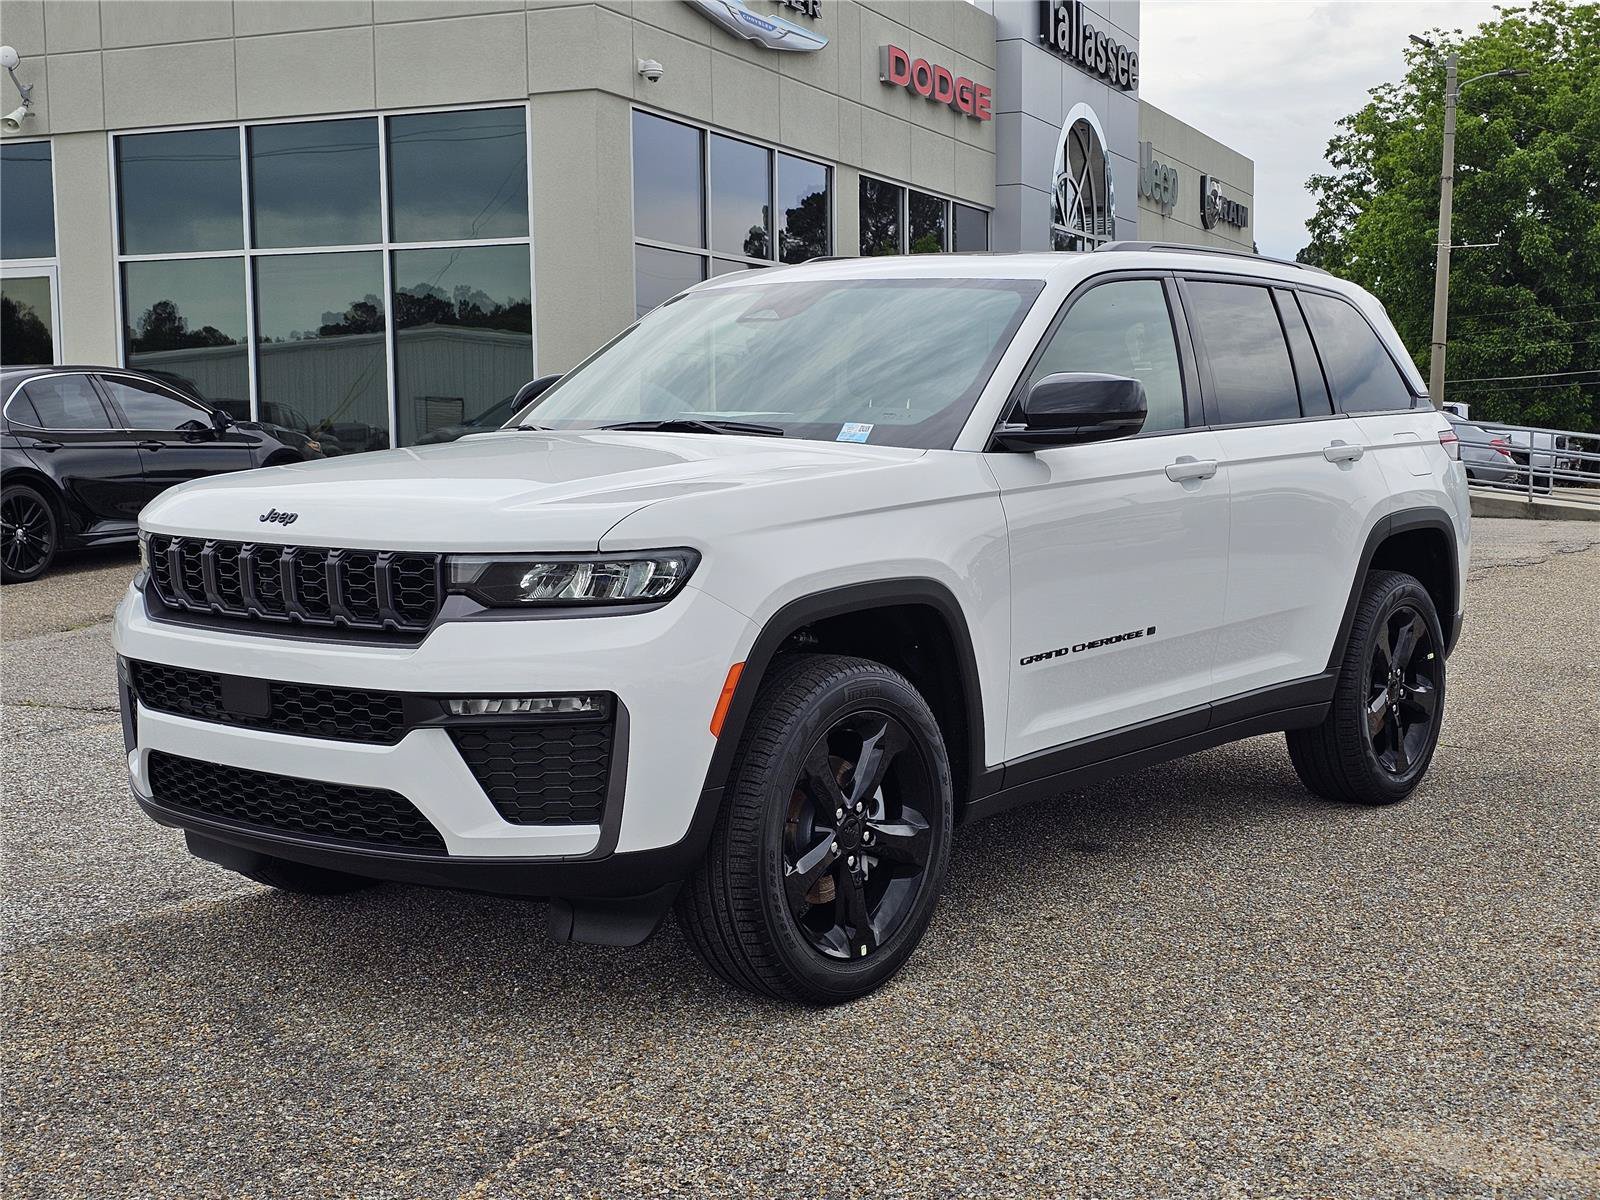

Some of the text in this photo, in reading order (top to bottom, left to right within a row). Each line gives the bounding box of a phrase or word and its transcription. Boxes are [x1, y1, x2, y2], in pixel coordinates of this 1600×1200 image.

[1047, 0, 1139, 91] Tallassee
[886, 44, 992, 121] DODGE
[1138, 141, 1178, 216] Jeep
[1219, 195, 1249, 228] RAM
[259, 507, 298, 527] Jeep
[1019, 629, 1144, 666] GRAND CHEROKEE
